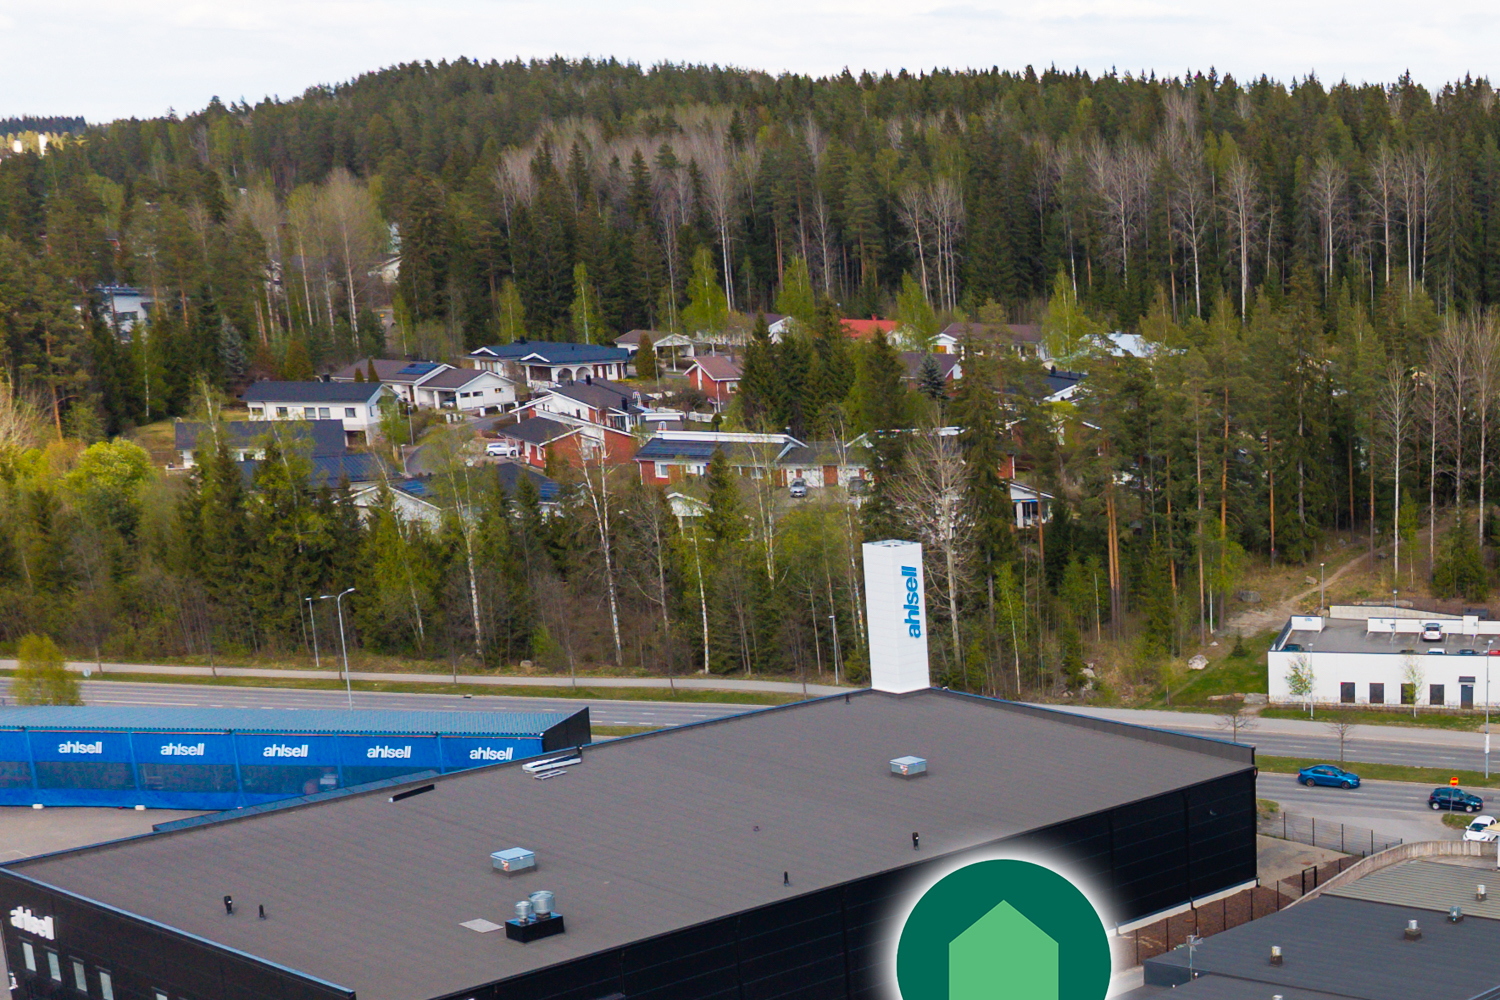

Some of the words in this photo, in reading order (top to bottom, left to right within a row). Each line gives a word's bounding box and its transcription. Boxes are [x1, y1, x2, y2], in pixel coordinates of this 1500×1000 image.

[901, 565, 921, 638] ahlsell
[58, 741, 102, 755] ahlsell
[161, 743, 205, 756] ahlsell
[263, 744, 308, 758] ahlsell
[367, 745, 411, 759] ahlsell
[469, 746, 513, 760] ahlsell
[10, 906, 54, 940] ahlsell
